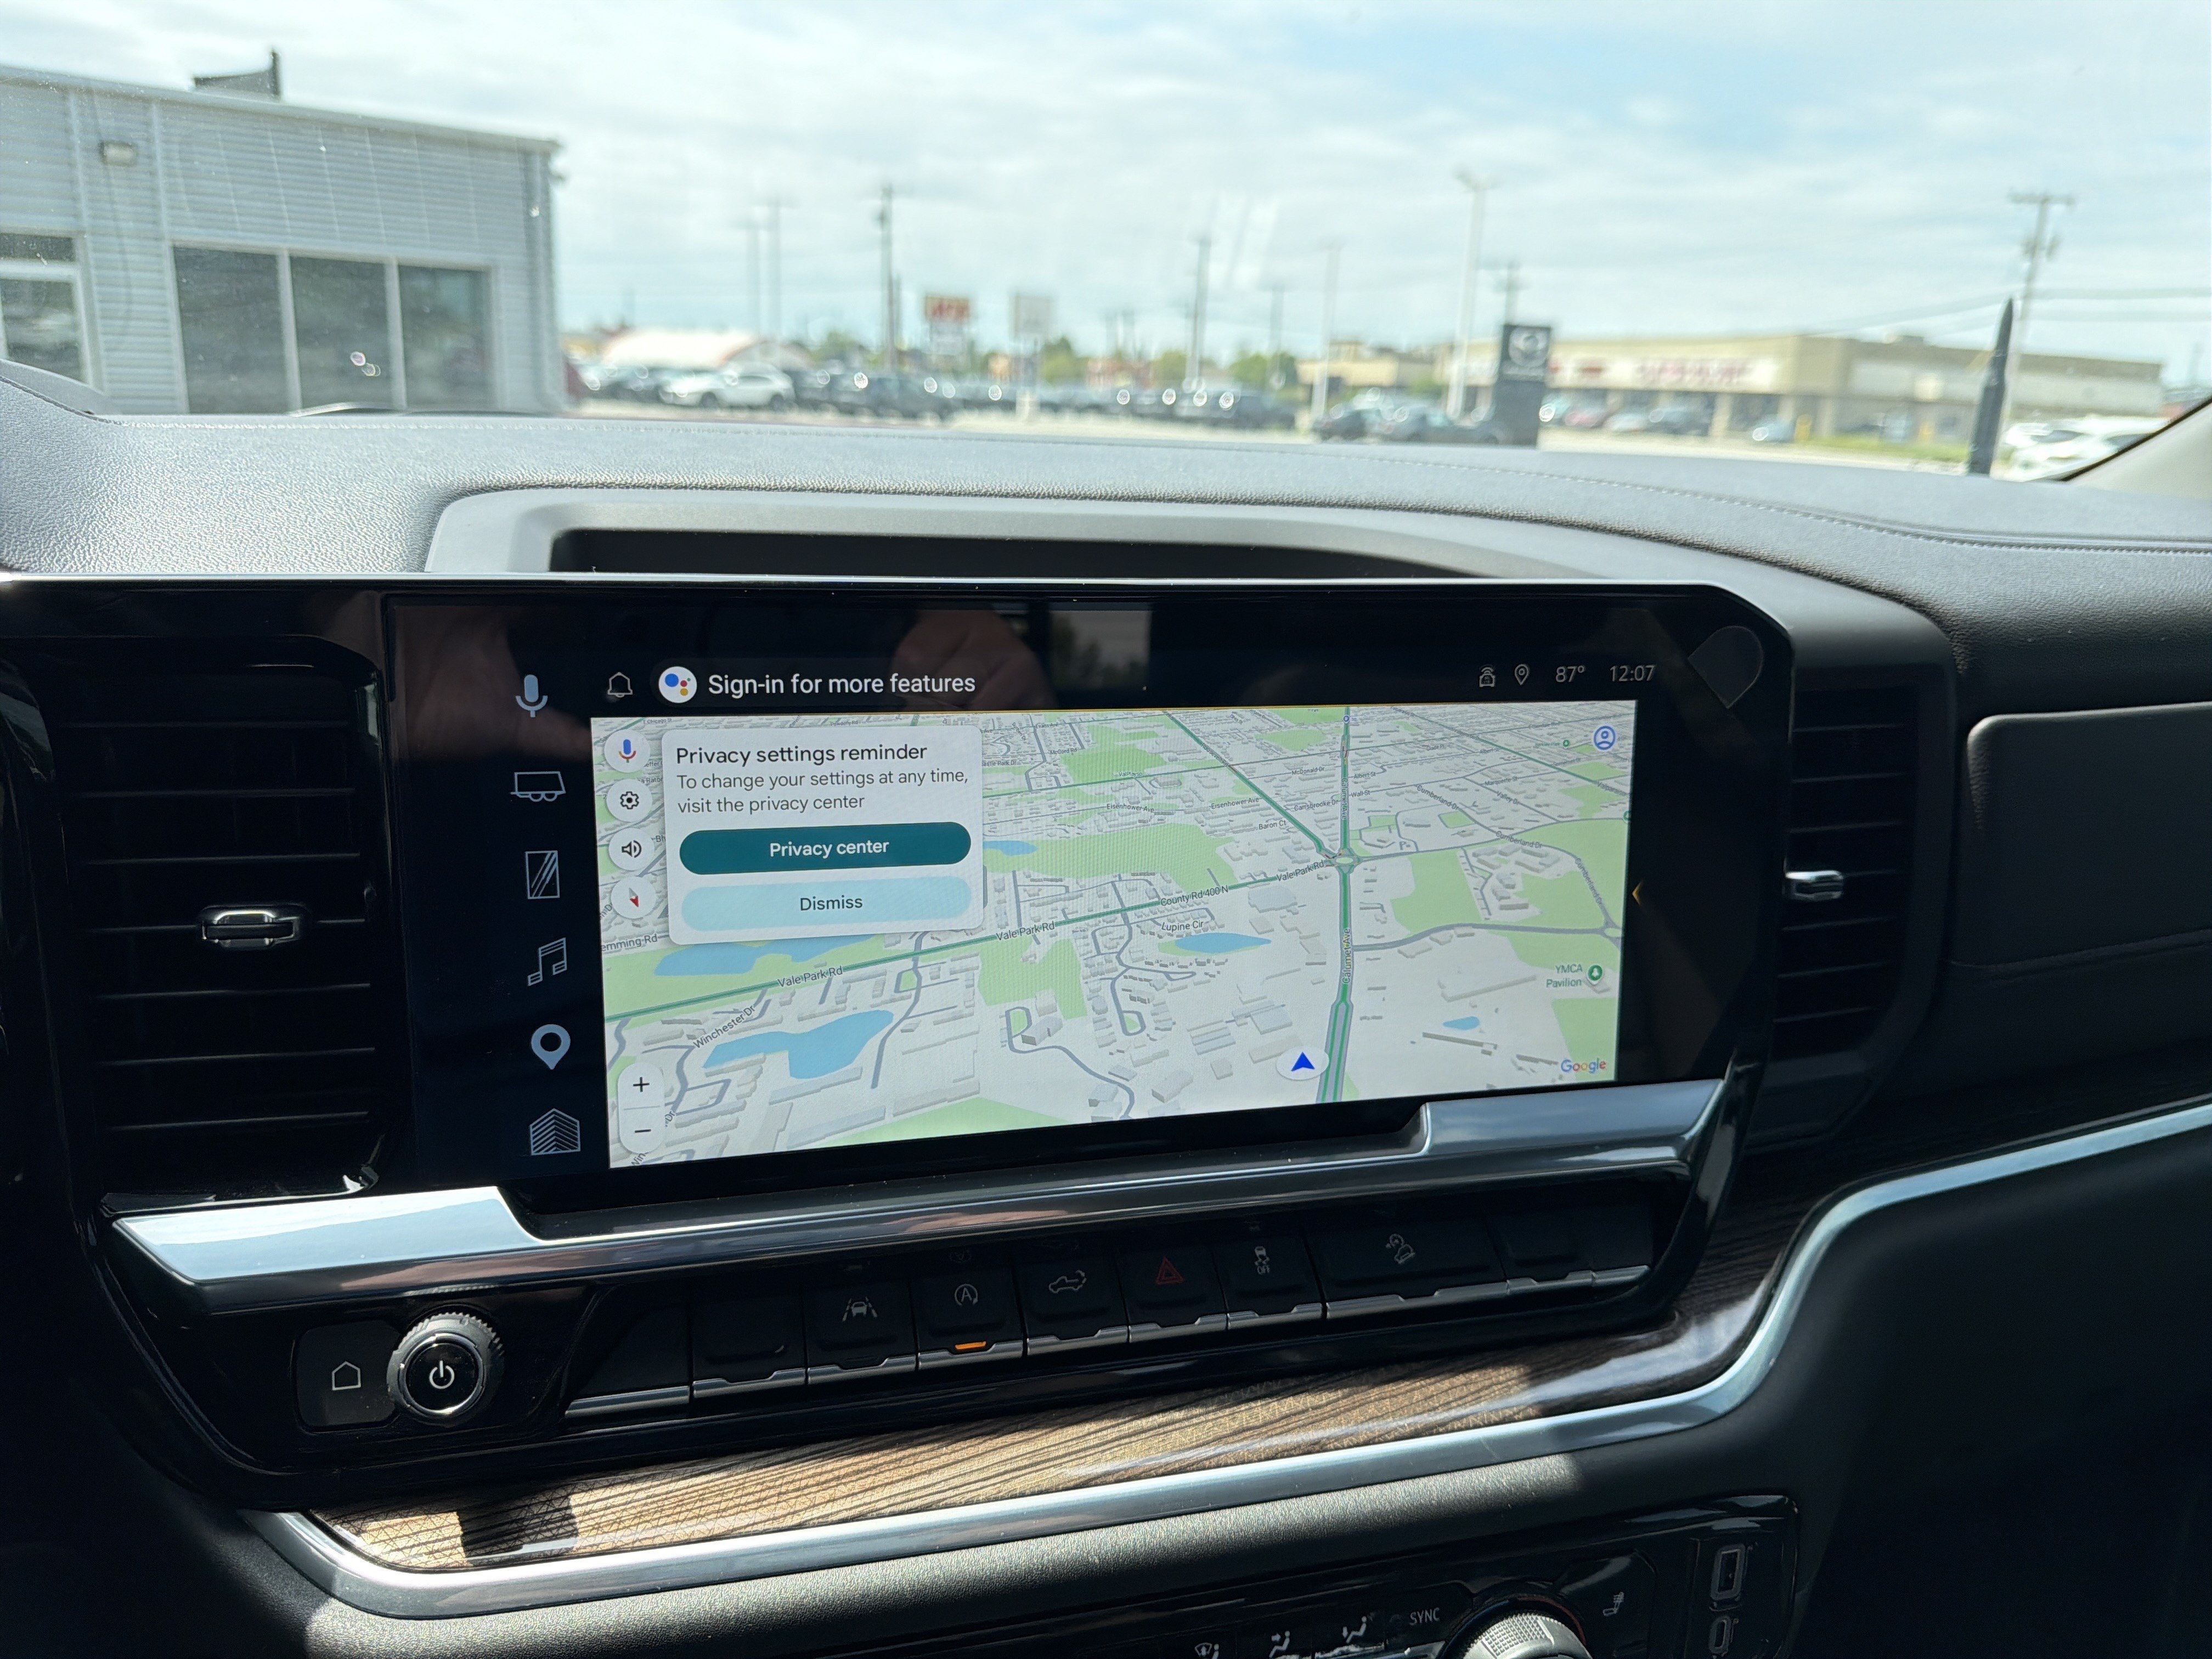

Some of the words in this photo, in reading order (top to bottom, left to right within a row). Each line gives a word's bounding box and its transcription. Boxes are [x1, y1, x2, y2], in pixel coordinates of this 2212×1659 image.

[1555, 665, 1585, 682] 87°
[1610, 665, 1656, 681] 12:07
[709, 674, 784, 699] Sign-in
[791, 673, 822, 693] for
[828, 678, 884, 693] more
[889, 673, 975, 692] features
[677, 747, 751, 768] Privacy
[757, 745, 836, 766] settings
[841, 744, 927, 760] reminder
[676, 775, 697, 789] To
[702, 773, 764, 791] change
[769, 775, 805, 790] your
[810, 770, 874, 788] settings
[879, 771, 893, 784] at
[899, 772, 926, 786] any
[930, 768, 968, 784] time,
[678, 798, 712, 813] visit
[716, 797, 744, 812] the
[749, 796, 808, 815] privacy
[813, 795, 865, 810] center
[1211, 799, 1246, 810] Eisenhower
[1417, 785, 1451, 808] Cumberland
[1107, 803, 1143, 811] Eisenhower
[1496, 830, 1534, 848] Cumberland
[770, 841, 833, 859] Privacy
[837, 840, 890, 855] center
[1277, 872, 1294, 882] Vale
[1295, 865, 1312, 876] Park
[1313, 860, 1324, 869] Rd
[800, 894, 863, 911] Dismiss
[1161, 895, 1190, 906] County
[1191, 888, 1203, 899] Rd
[1204, 887, 1220, 897] 400
[1221, 885, 1229, 894] N
[996, 929, 1017, 941] Vale
[1019, 926, 1040, 936] Park
[1042, 922, 1056, 932] Rd
[1161, 922, 1190, 933] Lupine
[1192, 920, 1204, 929] Cir
[1342, 928, 1351, 944] Ave
[644, 933, 658, 943] Rd
[1342, 947, 1352, 984] Calumet
[1555, 964, 1583, 974] YMCA
[777, 975, 802, 988] Vale
[804, 969, 827, 983] Park
[828, 966, 843, 977] Rd
[1546, 978, 1582, 988] Pavilion
[692, 1013, 745, 1048] Winchester
[744, 1005, 756, 1017] Dr
[1560, 1057, 1607, 1074] Google
[1409, 1607, 1440, 1626] SYNC
